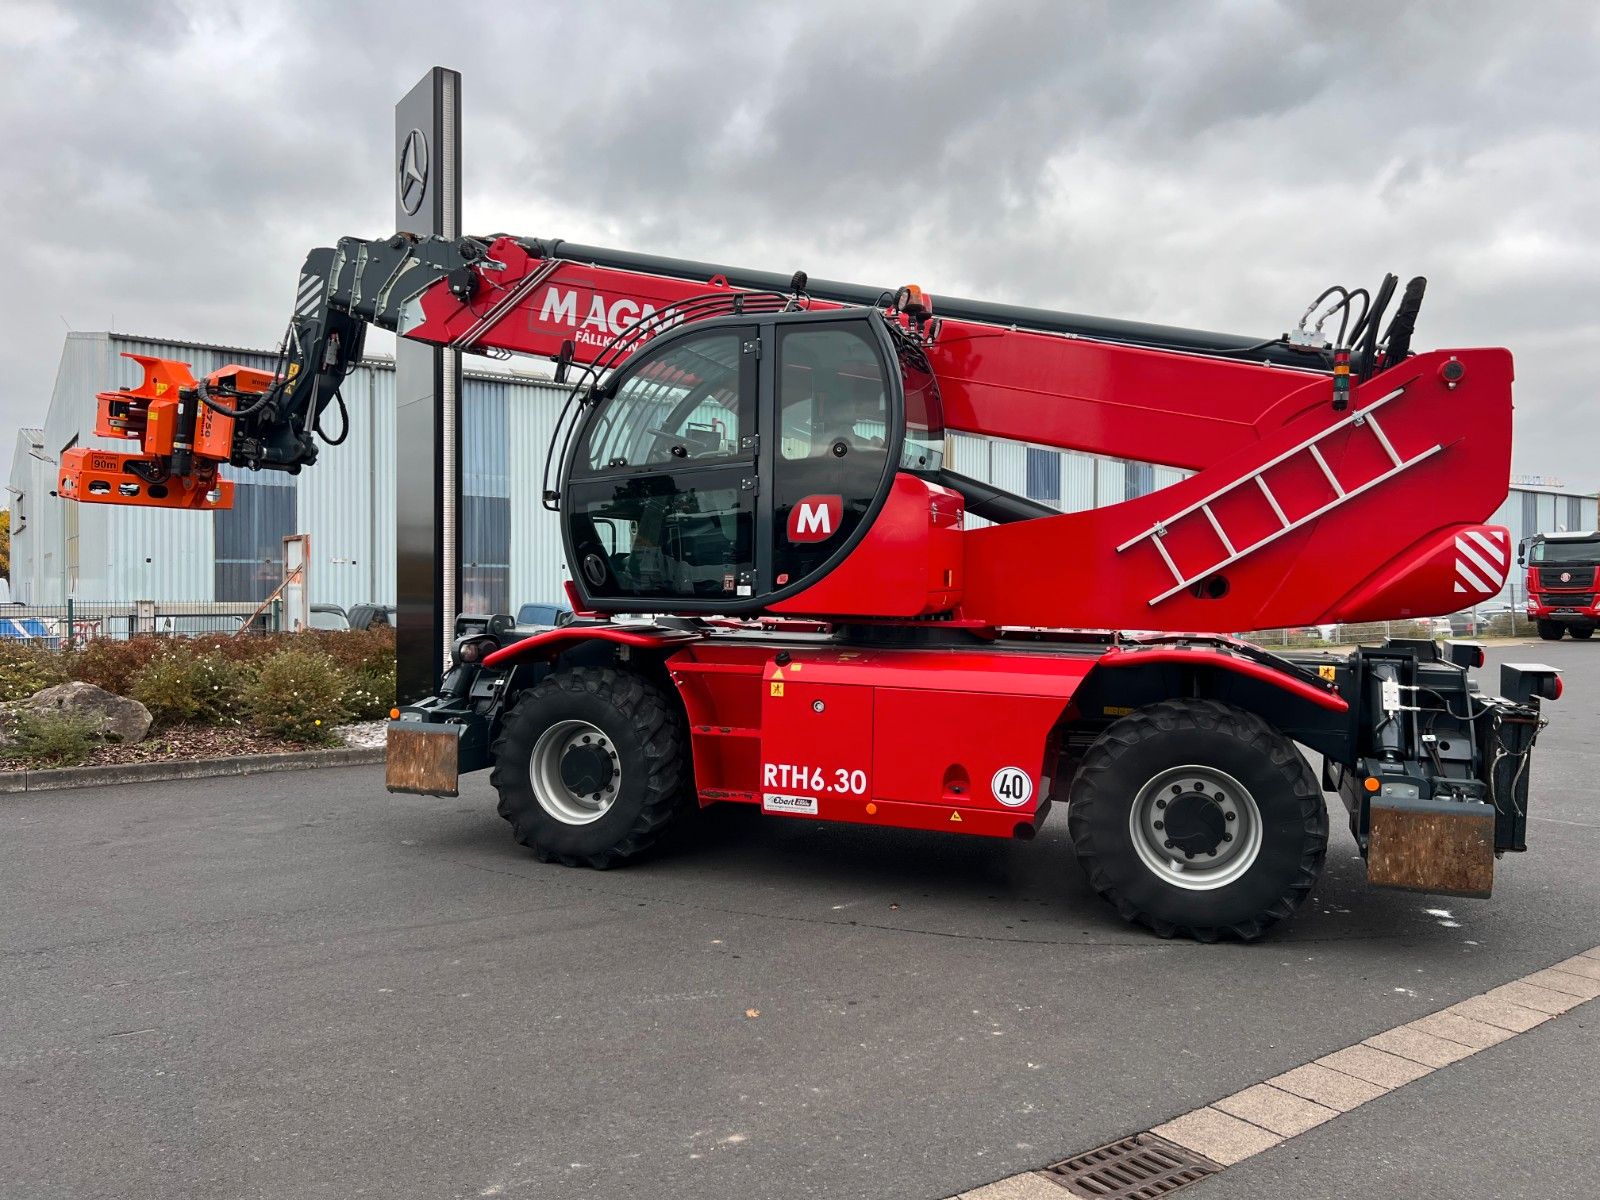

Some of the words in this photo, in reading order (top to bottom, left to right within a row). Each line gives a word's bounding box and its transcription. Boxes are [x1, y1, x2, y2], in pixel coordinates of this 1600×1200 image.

[94, 460, 116, 469] 90m
[796, 503, 831, 533] M
[763, 763, 867, 795] RTH6.30
[999, 774, 1023, 799] 40
